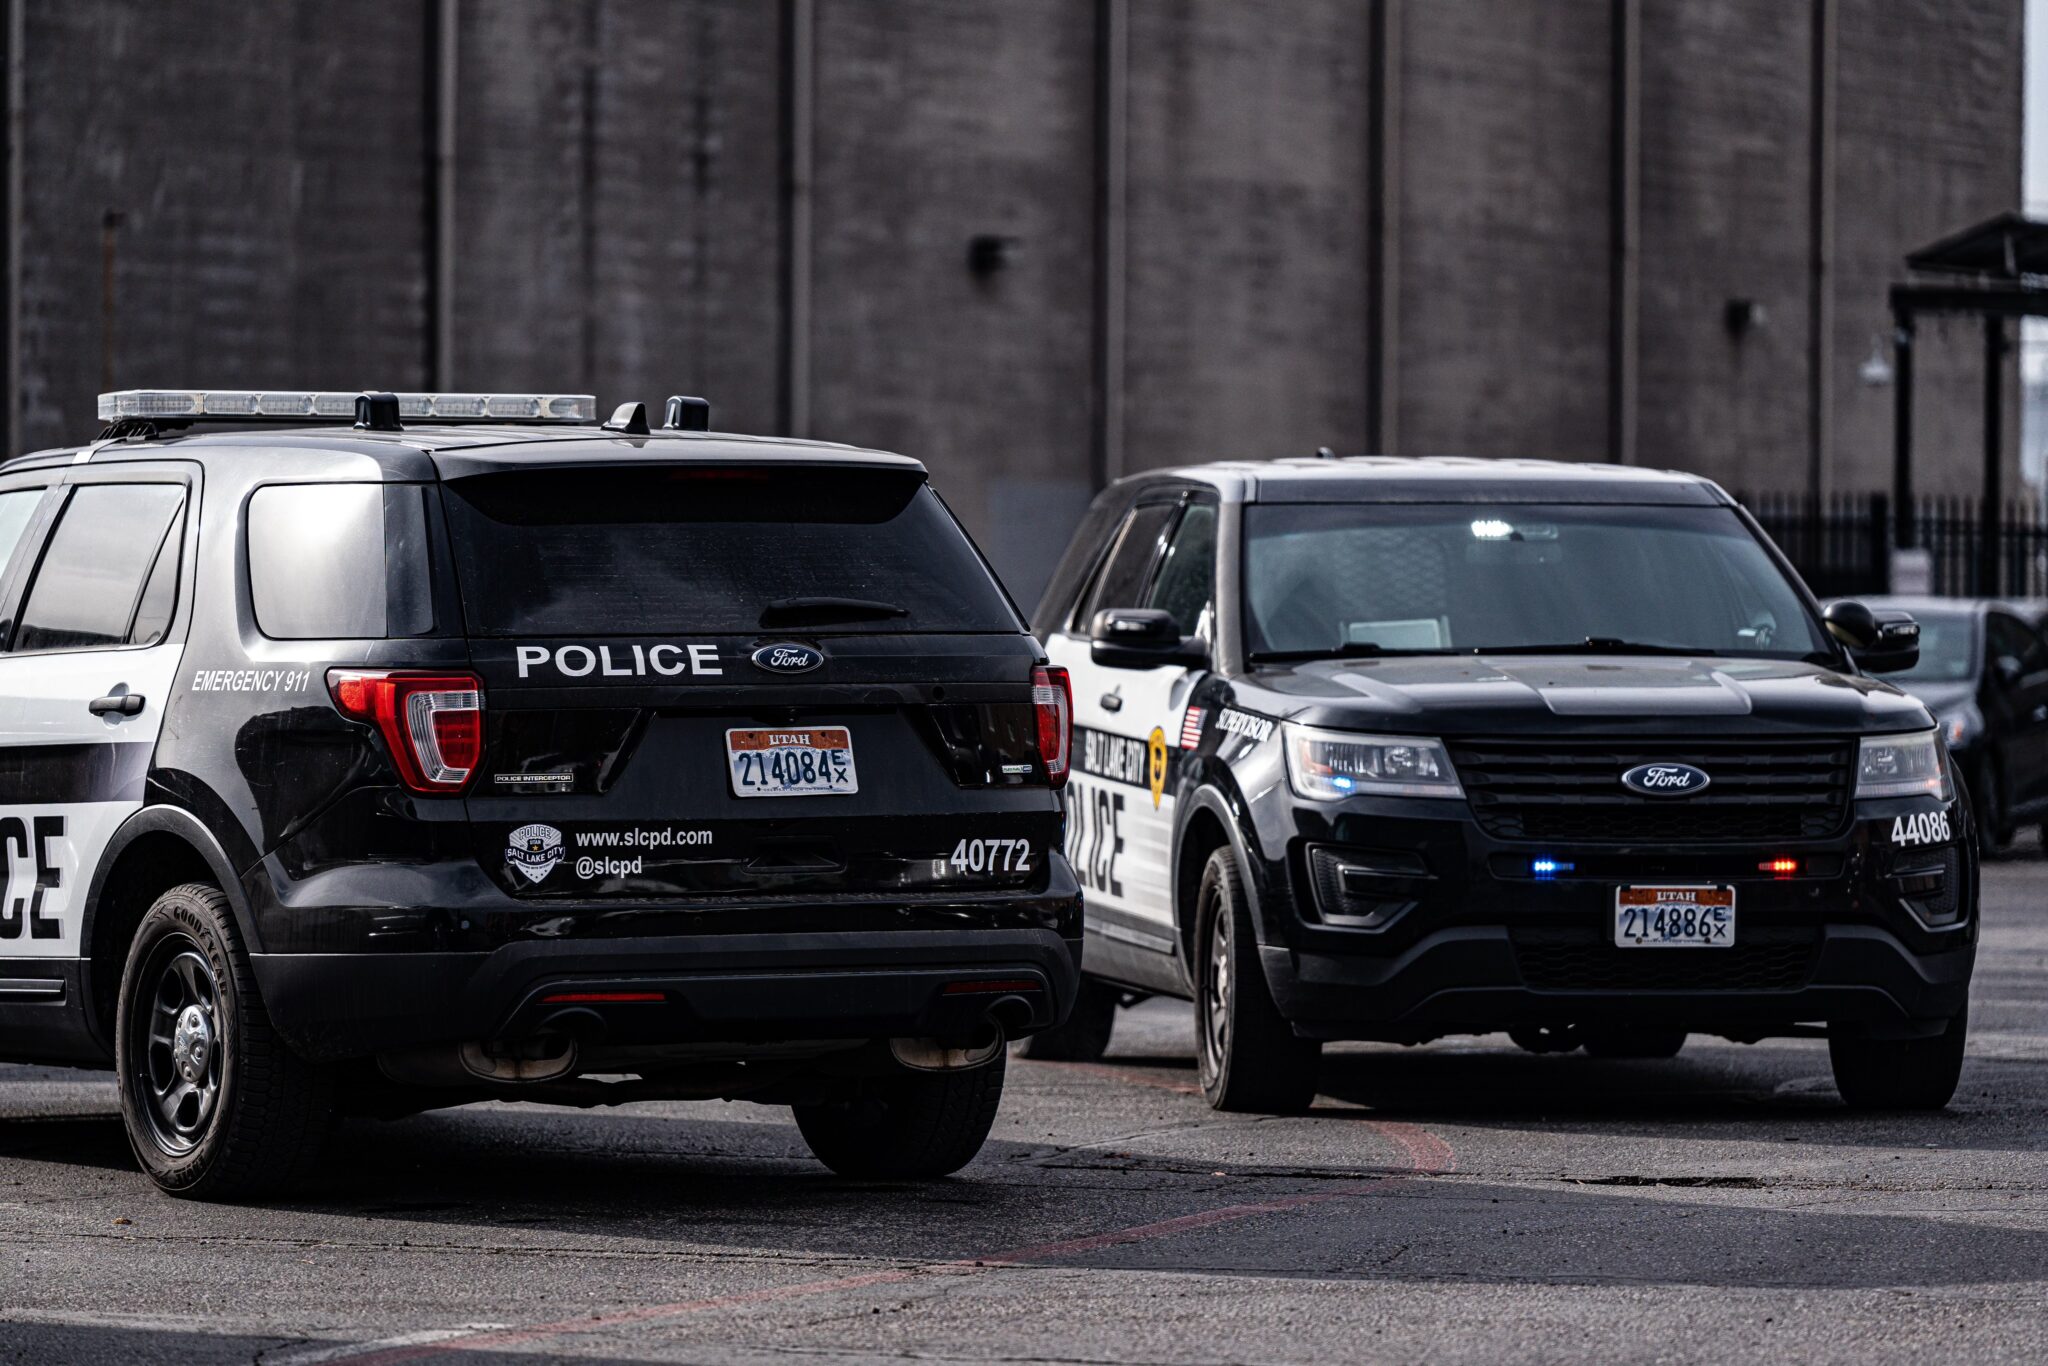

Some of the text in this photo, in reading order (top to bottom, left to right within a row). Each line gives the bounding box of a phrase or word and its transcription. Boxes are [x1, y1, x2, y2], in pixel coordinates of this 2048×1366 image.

[516, 644, 723, 678] POLICE
[770, 648, 809, 667] Ford
[191, 670, 311, 692] EMERGENCY 911
[768, 734, 811, 746] UTAH
[1643, 767, 1690, 787] Ford
[519, 826, 552, 840] POLICE
[575, 827, 713, 850] www.slcpd.com
[1891, 810, 1950, 847] 44086
[507, 846, 563, 862] SALT LAKE CITY
[950, 838, 1030, 872] 40772
[575, 855, 642, 879] @slcpd
[1656, 891, 1697, 902] UTAH
